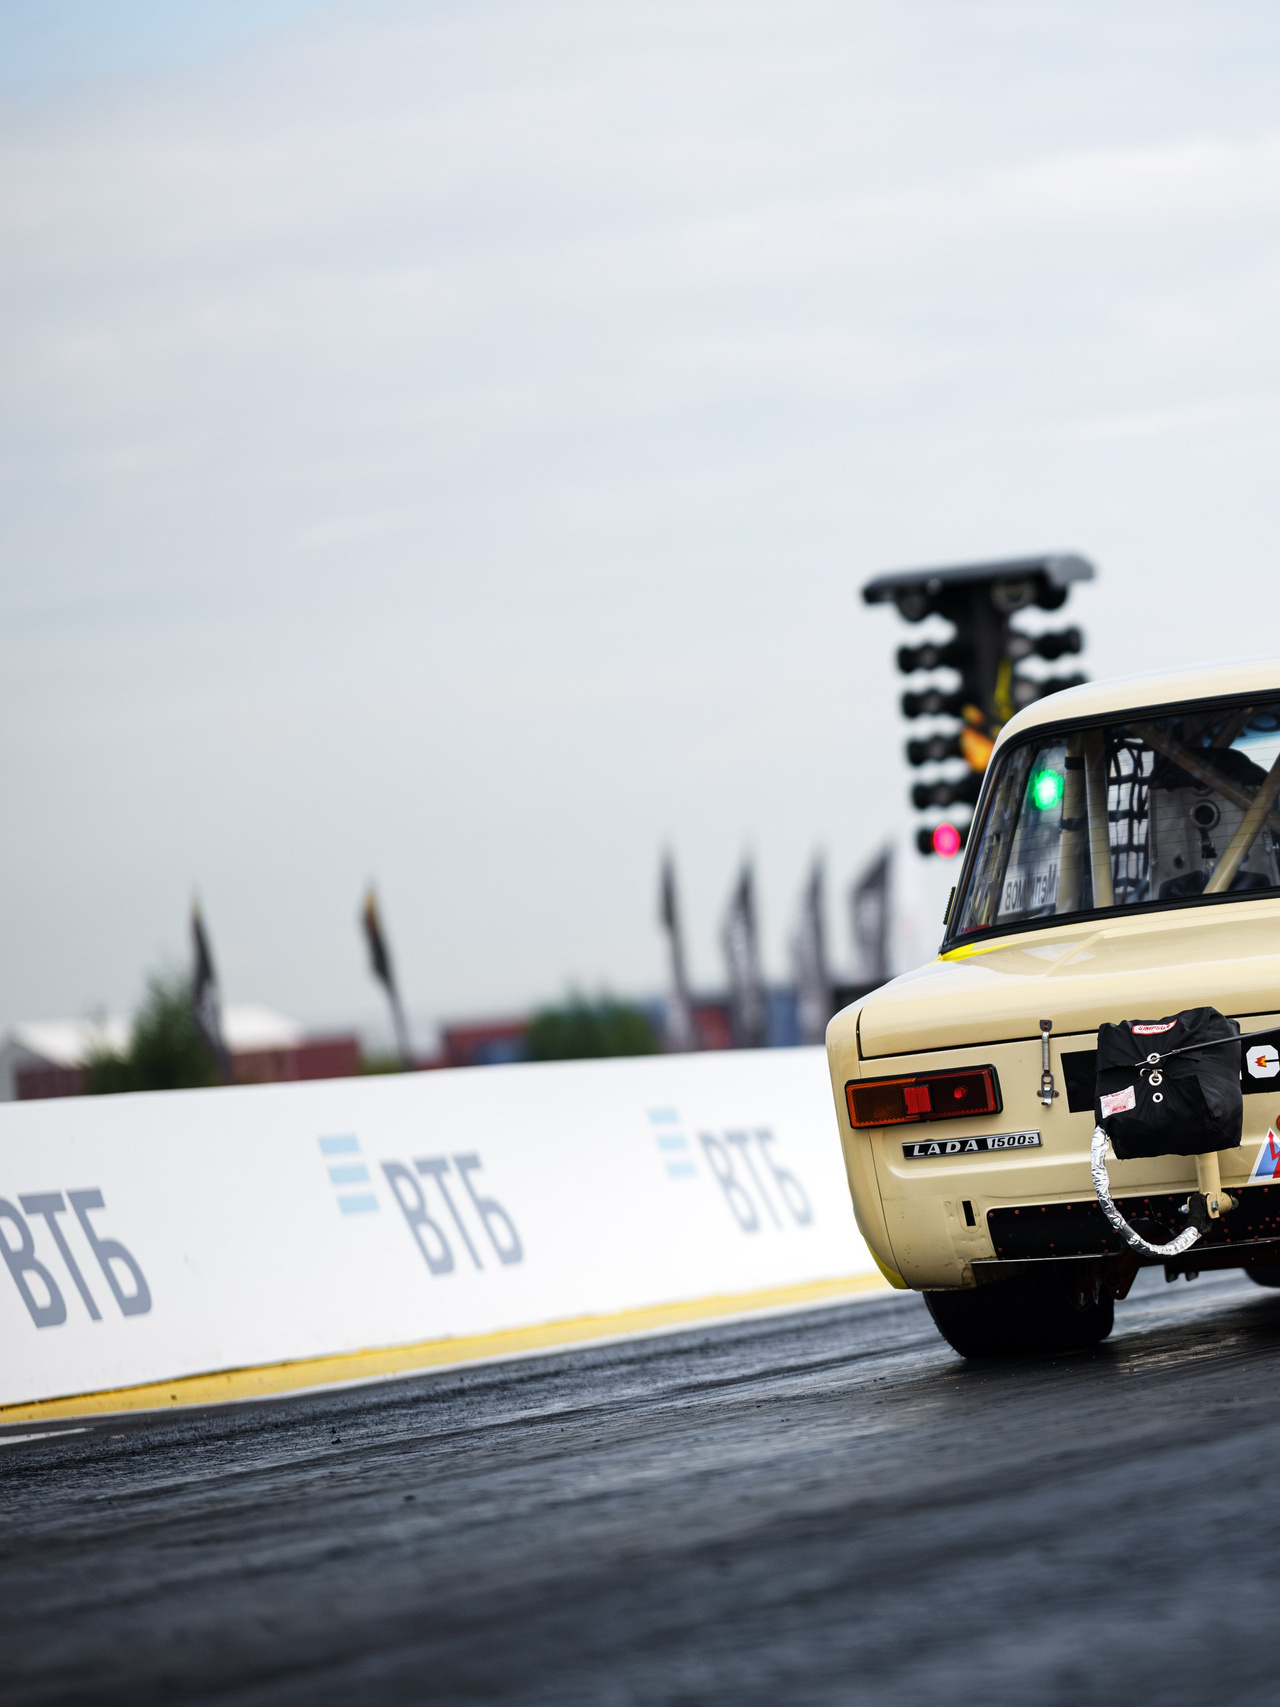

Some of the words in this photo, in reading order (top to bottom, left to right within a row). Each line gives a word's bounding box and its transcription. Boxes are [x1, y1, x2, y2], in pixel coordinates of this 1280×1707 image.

[698, 1128, 814, 1233] ВТБ
[912, 1139, 979, 1157] LADA
[991, 1135, 1035, 1148] 1500s
[0, 1187, 152, 1329] ВТБ
[380, 1151, 525, 1278] ВТБ
